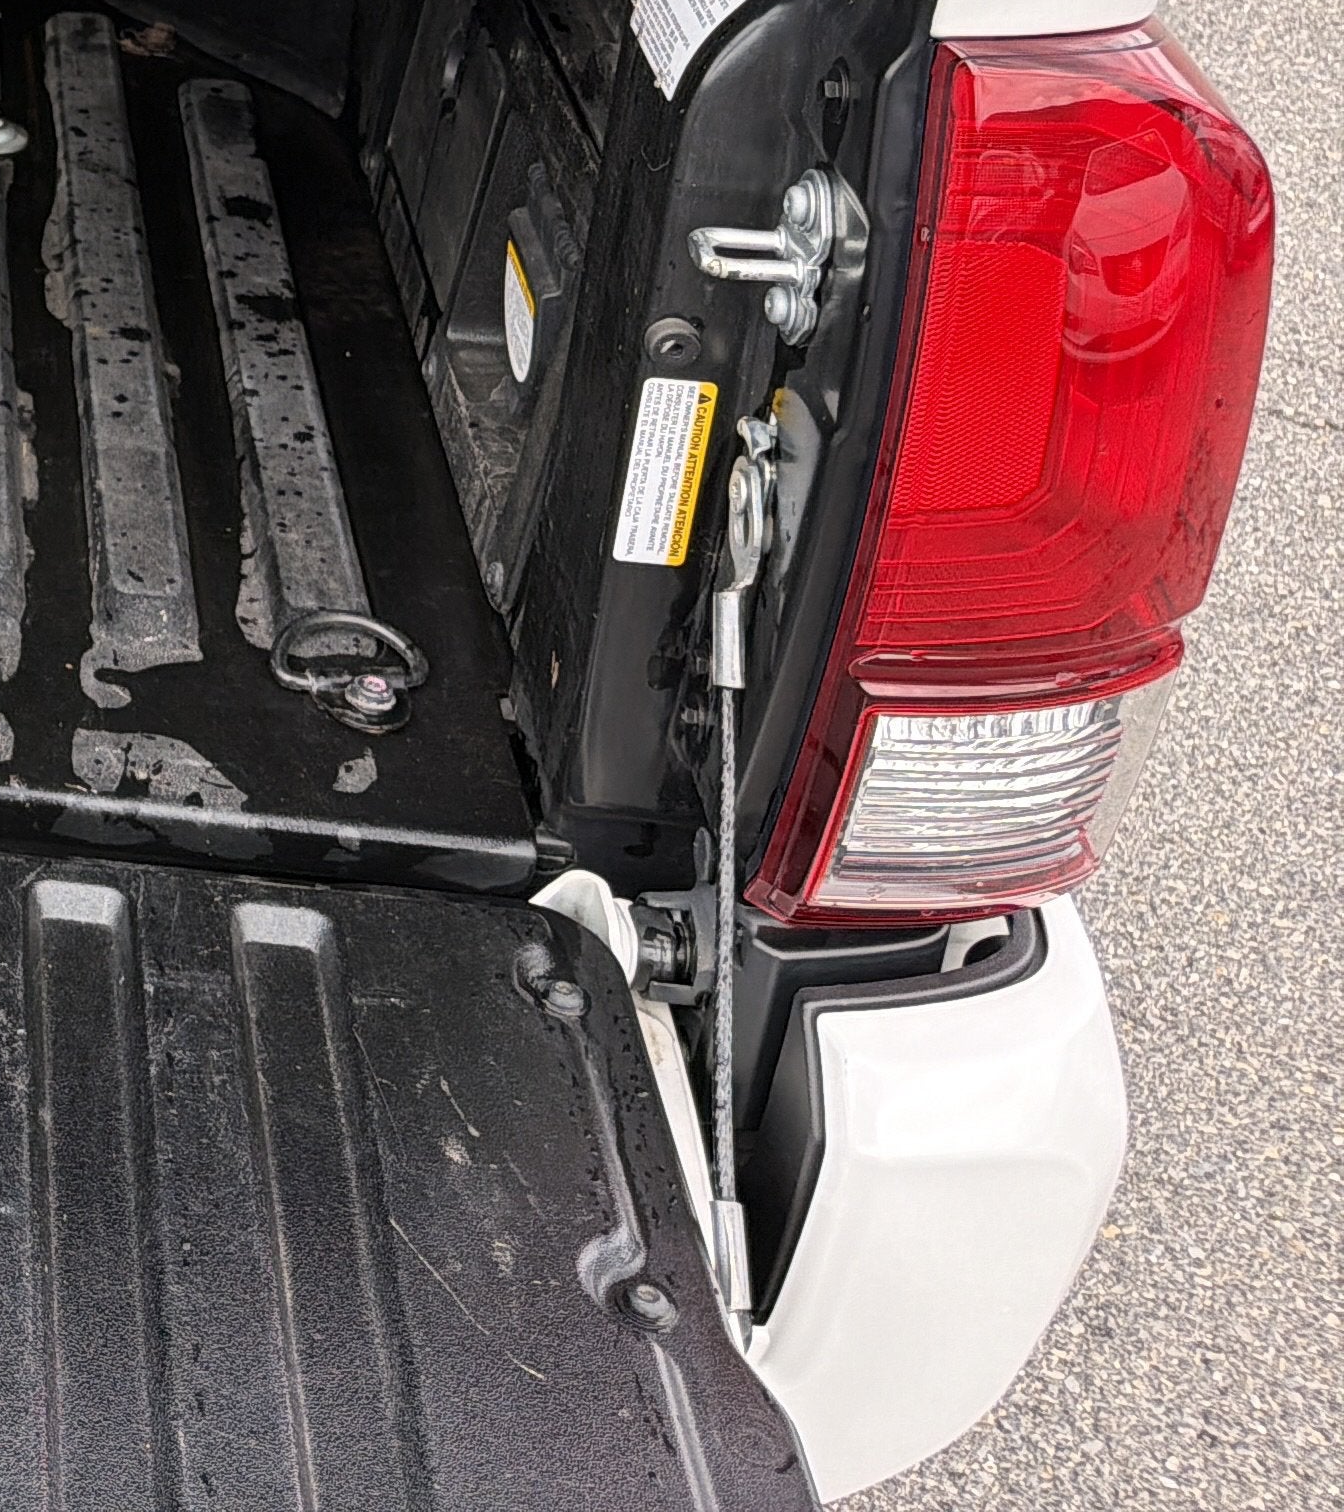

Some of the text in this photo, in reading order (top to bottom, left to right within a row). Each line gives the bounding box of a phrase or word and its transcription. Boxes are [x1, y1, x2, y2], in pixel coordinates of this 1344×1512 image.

[642, 382, 655, 417] CONSULTE
[653, 382, 664, 405] ANTES
[670, 385, 684, 425] CONSULTER
[686, 385, 695, 398] SEE
[680, 400, 692, 432] OWNER'S
[634, 429, 646, 456] MANUAL
[645, 417, 657, 447] RETIRAR
[662, 436, 674, 464] MANUEL
[674, 433, 686, 461] MANUAL
[632, 458, 641, 471] DEL
[638, 458, 650, 484] PUERTA
[669, 462, 681, 489] BEFORE
[668, 406, 707, 557] CAUTION ATTENTION ATENCIÓN
[631, 506, 641, 523] CAJA
[663, 492, 675, 521] TAILGATE
